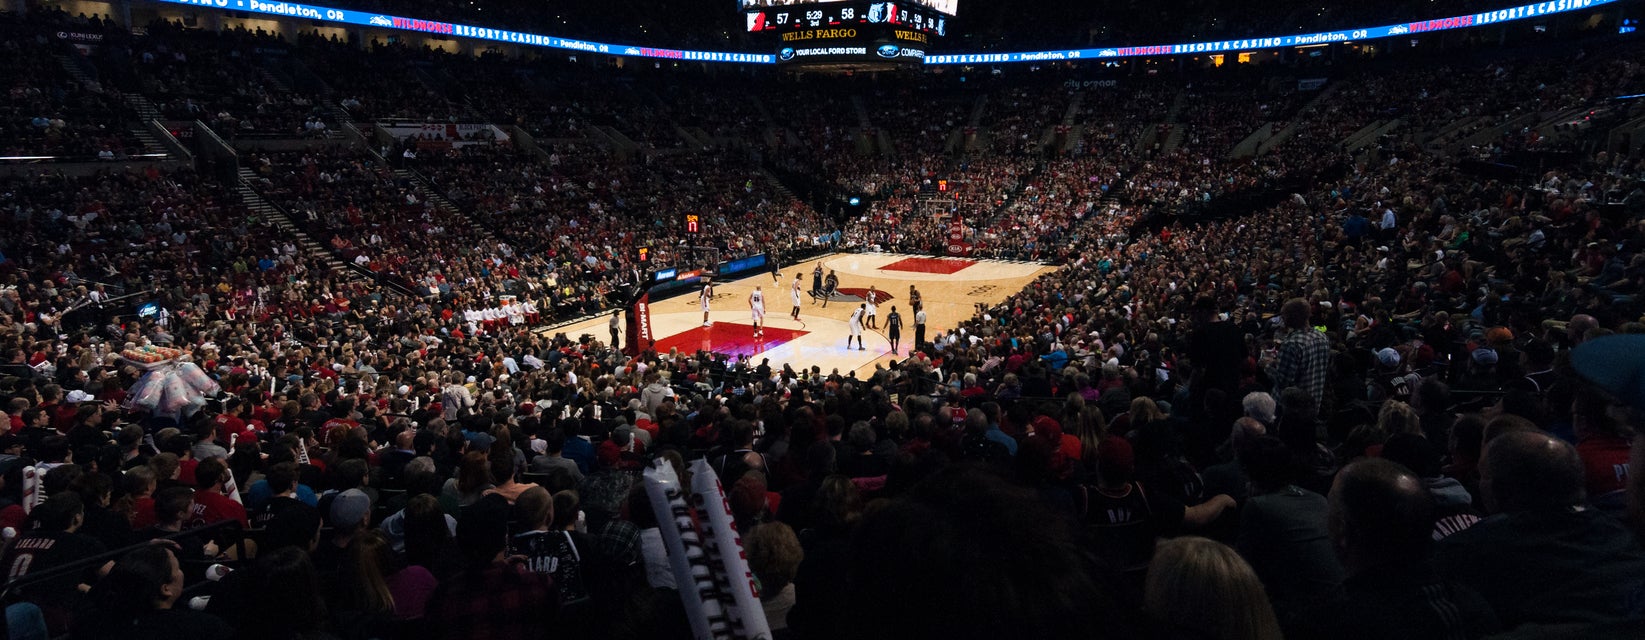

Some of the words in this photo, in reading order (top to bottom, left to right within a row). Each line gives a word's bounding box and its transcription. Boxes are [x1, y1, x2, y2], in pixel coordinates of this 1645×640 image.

[250, 1, 322, 19] Pendleton,
[327, 10, 344, 21] OR
[806, 10, 823, 20] 5:29
[841, 8, 854, 19] 58
[901, 10, 908, 21] 57
[1409, 15, 1473, 33] WILDHORSE
[1476, 6, 1525, 24] RESORT
[1527, 5, 1535, 16] &
[1538, 0, 1592, 14] CASINO
[776, 13, 789, 24] 57
[391, 16, 453, 34] WILDHORSE
[456, 25, 500, 40] RESORT
[502, 31, 509, 41] &
[511, 32, 550, 46] CASINO
[782, 31, 813, 41] WELLS
[816, 28, 856, 39] FARGO
[895, 30, 922, 42] WELLS
[1295, 33, 1348, 44] Pendleton,
[1352, 30, 1367, 39] OR
[599, 44, 609, 53] OR
[845, 47, 867, 55] STORE
[1117, 45, 1172, 56] WILDHORSE
[1175, 42, 1220, 53] RESORT
[1223, 41, 1230, 50] &
[1233, 37, 1282, 49] CASINO
[685, 51, 723, 61] RESORT
[733, 53, 770, 63] CASINO
[925, 55, 959, 64] ESORT
[969, 54, 1009, 63] CASINO
[1068, 50, 1081, 59] OR
[639, 303, 649, 340] BI-MART
